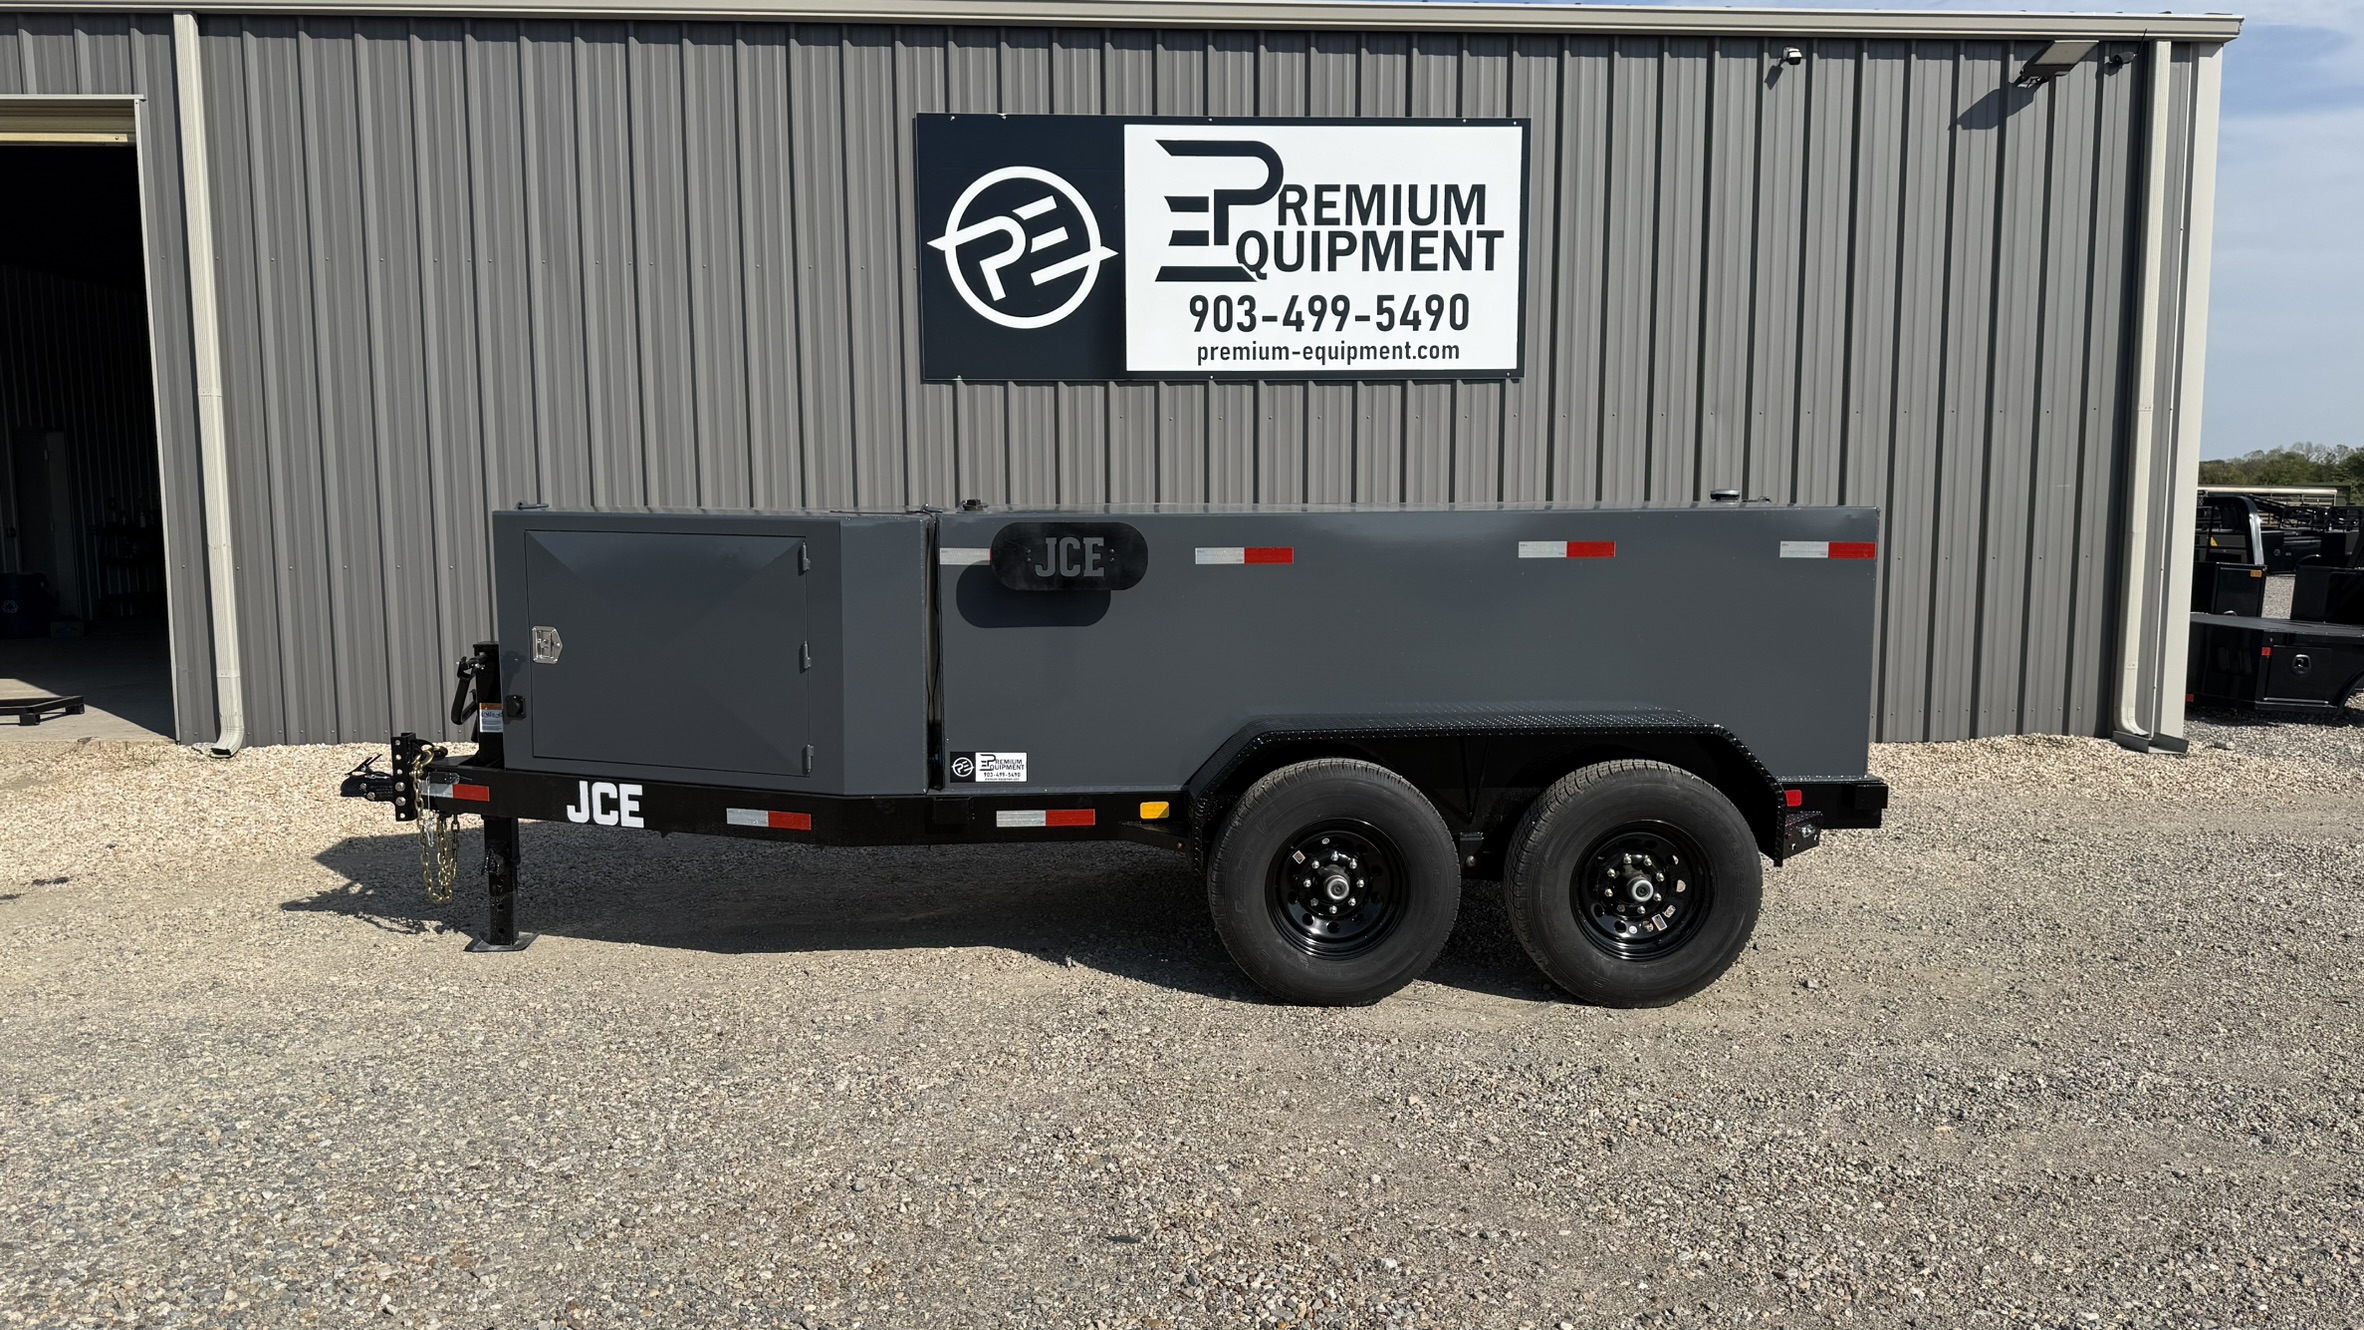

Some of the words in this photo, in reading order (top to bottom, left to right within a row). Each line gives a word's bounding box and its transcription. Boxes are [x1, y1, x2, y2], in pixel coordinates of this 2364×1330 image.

[1189, 293, 1470, 333] 903-499-5490
[1197, 340, 1460, 366] premium-equipment.com
[1034, 537, 1105, 577] JCE
[566, 780, 645, 829] JCE
